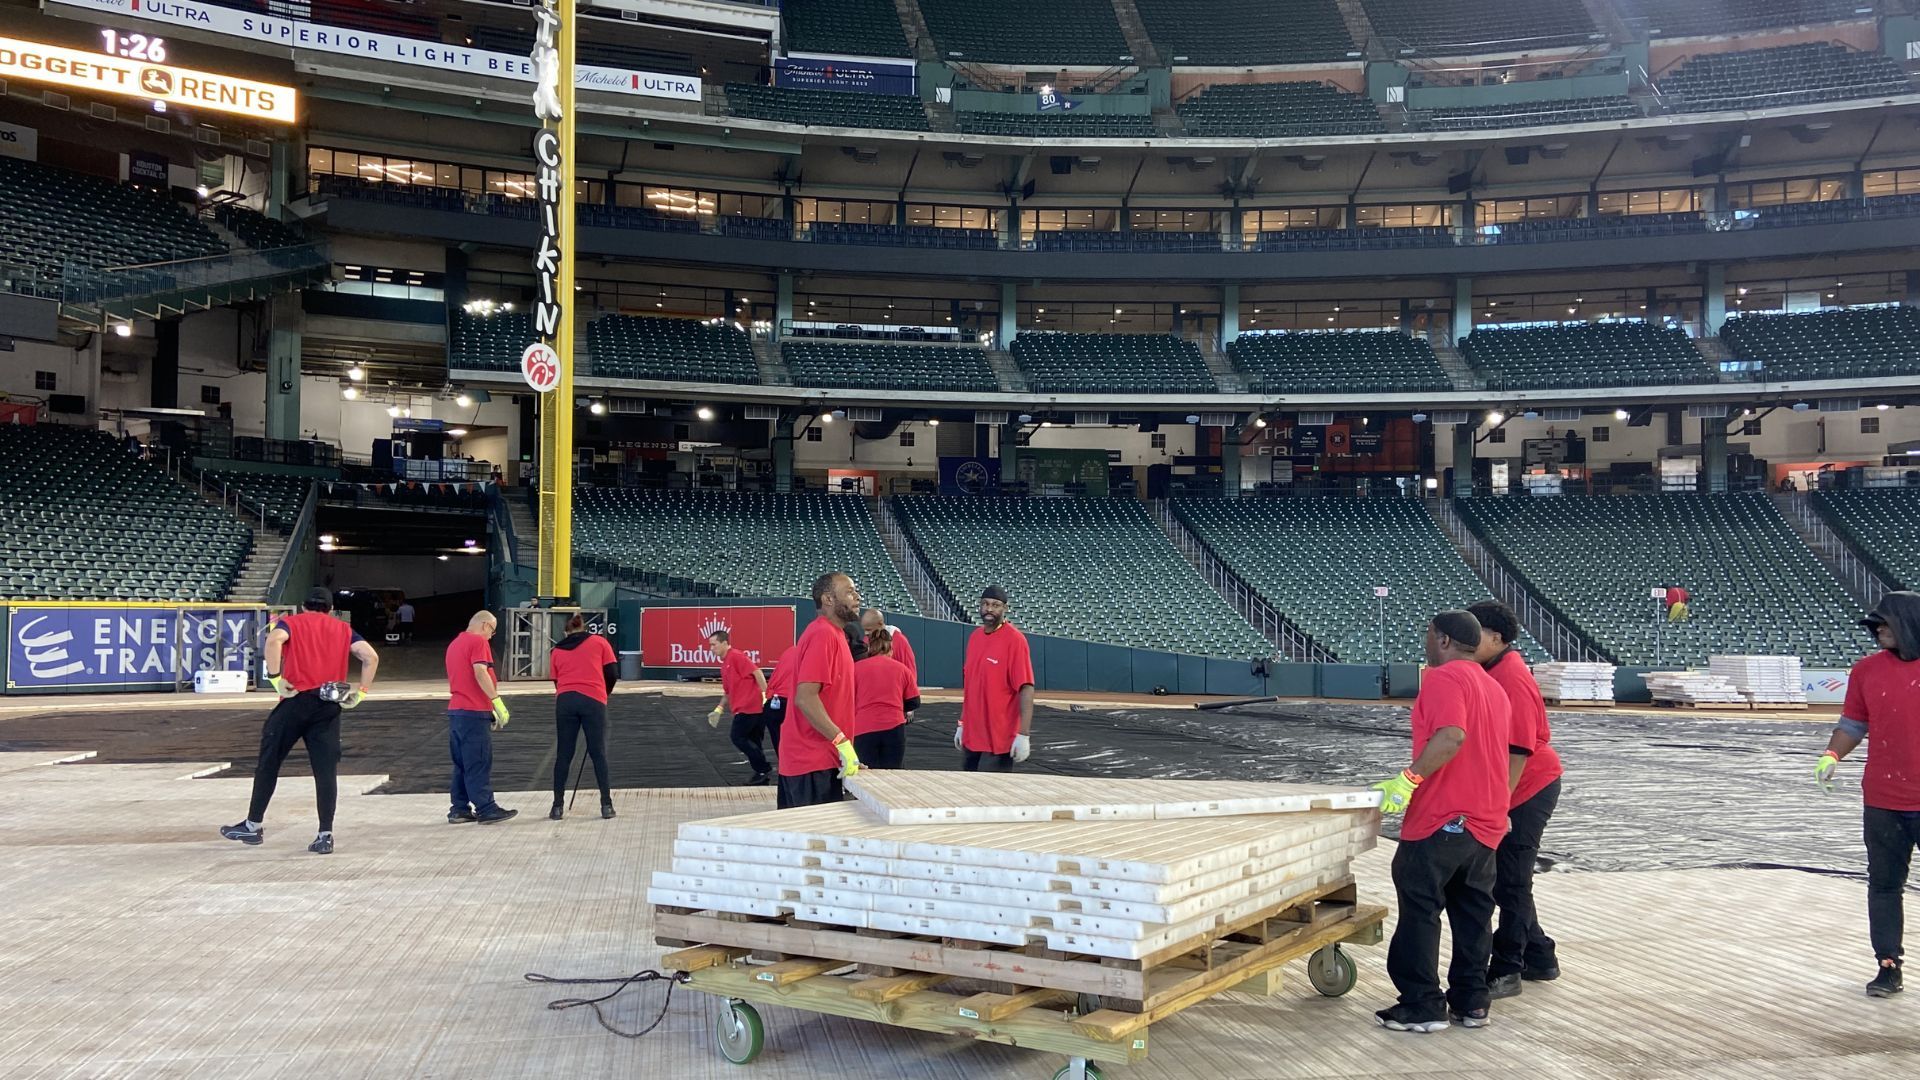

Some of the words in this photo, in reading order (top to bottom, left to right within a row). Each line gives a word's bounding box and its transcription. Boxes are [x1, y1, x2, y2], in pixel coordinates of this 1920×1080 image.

[147, 0, 210, 23] ULTRA
[101, 29, 166, 62] 1:26
[243, 18, 378, 51] SUPERIOR
[397, 44, 471, 65] LIGHT
[488, 58, 530, 75] BEE
[576, 70, 629, 87] Michelob
[644, 78, 697, 94] ULTRA
[835, 68, 875, 79] ULTRA
[181, 77, 275, 111] RENTS
[1042, 94, 1056, 105] 80
[537, 132, 558, 335] CHIKIN
[618, 441, 676, 450] LEGENDS
[94, 617, 246, 646] ENERGY
